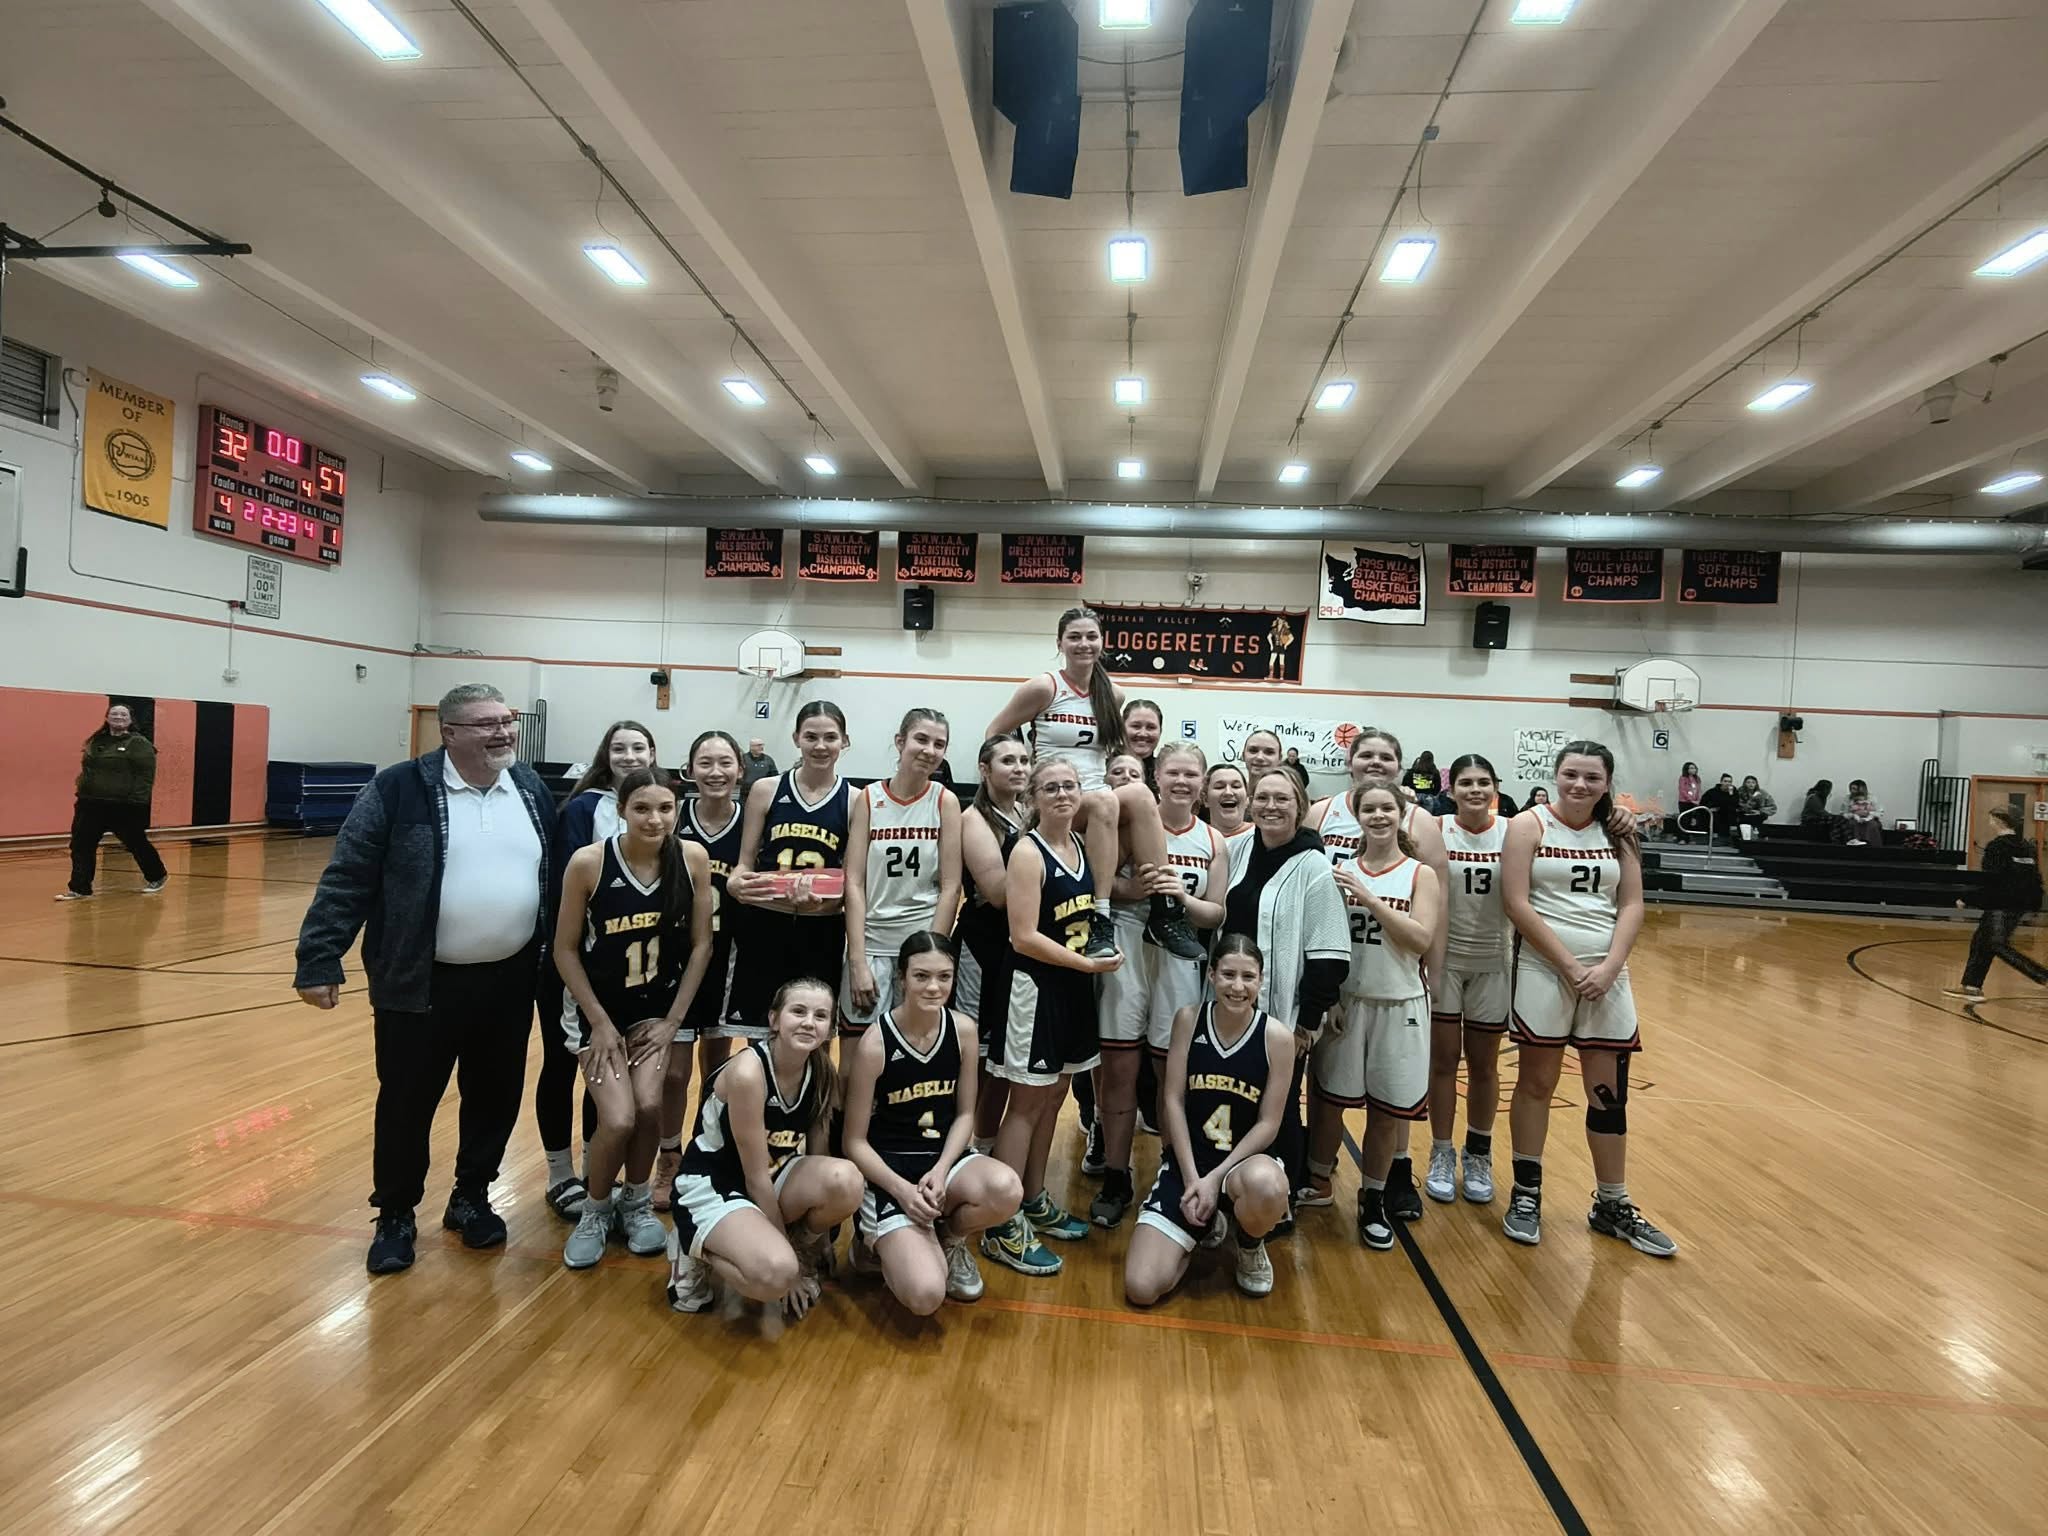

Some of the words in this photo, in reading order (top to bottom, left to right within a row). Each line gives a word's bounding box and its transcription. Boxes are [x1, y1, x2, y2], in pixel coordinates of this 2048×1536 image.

[99, 381, 165, 416] MEMBER
[122, 407, 143, 423] OF
[219, 413, 244, 432] Home
[219, 428, 248, 461] 32
[267, 430, 300, 464] 0.0
[268, 473, 295, 490] period
[319, 466, 344, 495] 57
[213, 474, 236, 490] fouls
[267, 493, 295, 508] player
[301, 480, 312, 497] 4
[117, 489, 150, 507] 1905
[220, 495, 232, 514] 4
[243, 501, 255, 521] 2
[304, 520, 315, 538] 4
[331, 529, 338, 545] 1
[721, 551, 765, 561] BASKETBALL
[816, 554, 861, 565] BASKETBALL
[914, 555, 960, 566] BASKETBALL
[1018, 556, 1065, 567] BASKETBALL
[717, 561, 771, 572] CHAMPIONS
[810, 563, 866, 576] CHAMPIONS
[911, 566, 963, 578] CHAMPIONS
[1013, 567, 1070, 578] CHAMPIONS
[1574, 562, 1656, 574] VOLLEYBALL
[1698, 564, 1767, 577] SOFTBALL
[1355, 569, 1388, 581] STATE
[1390, 571, 1419, 584] GIRLS
[1463, 570, 1487, 581] TRACK
[1497, 570, 1520, 581] FIELD
[1587, 575, 1639, 587] CHAMPS
[1704, 577, 1759, 589] CHAMPS
[1352, 579, 1420, 593] BASKETBALL
[1468, 582, 1514, 593] CHAMPIONS
[254, 591, 274, 601] LIMIT
[1354, 590, 1417, 605] CHAMPIONS
[1319, 606, 1344, 616] 29-0
[1104, 630, 1260, 655] LOGGERETTES
[758, 704, 768, 718] 4
[1184, 723, 1196, 737] 5
[1655, 733, 1668, 746] 6
[1306, 755, 1316, 764] in
[1322, 753, 1347, 768] her
[770, 822, 840, 851] NASELLE
[870, 827, 941, 841] OGGERETTE
[886, 846, 920, 877] 24
[1182, 872, 1199, 896] 3
[1463, 867, 1492, 895] 13
[1570, 865, 1601, 893] 21
[1349, 912, 1382, 946] 22
[625, 935, 660, 988] 11
[1189, 1073, 1261, 1104] NASELLE
[1202, 1104, 1233, 1152] 4
